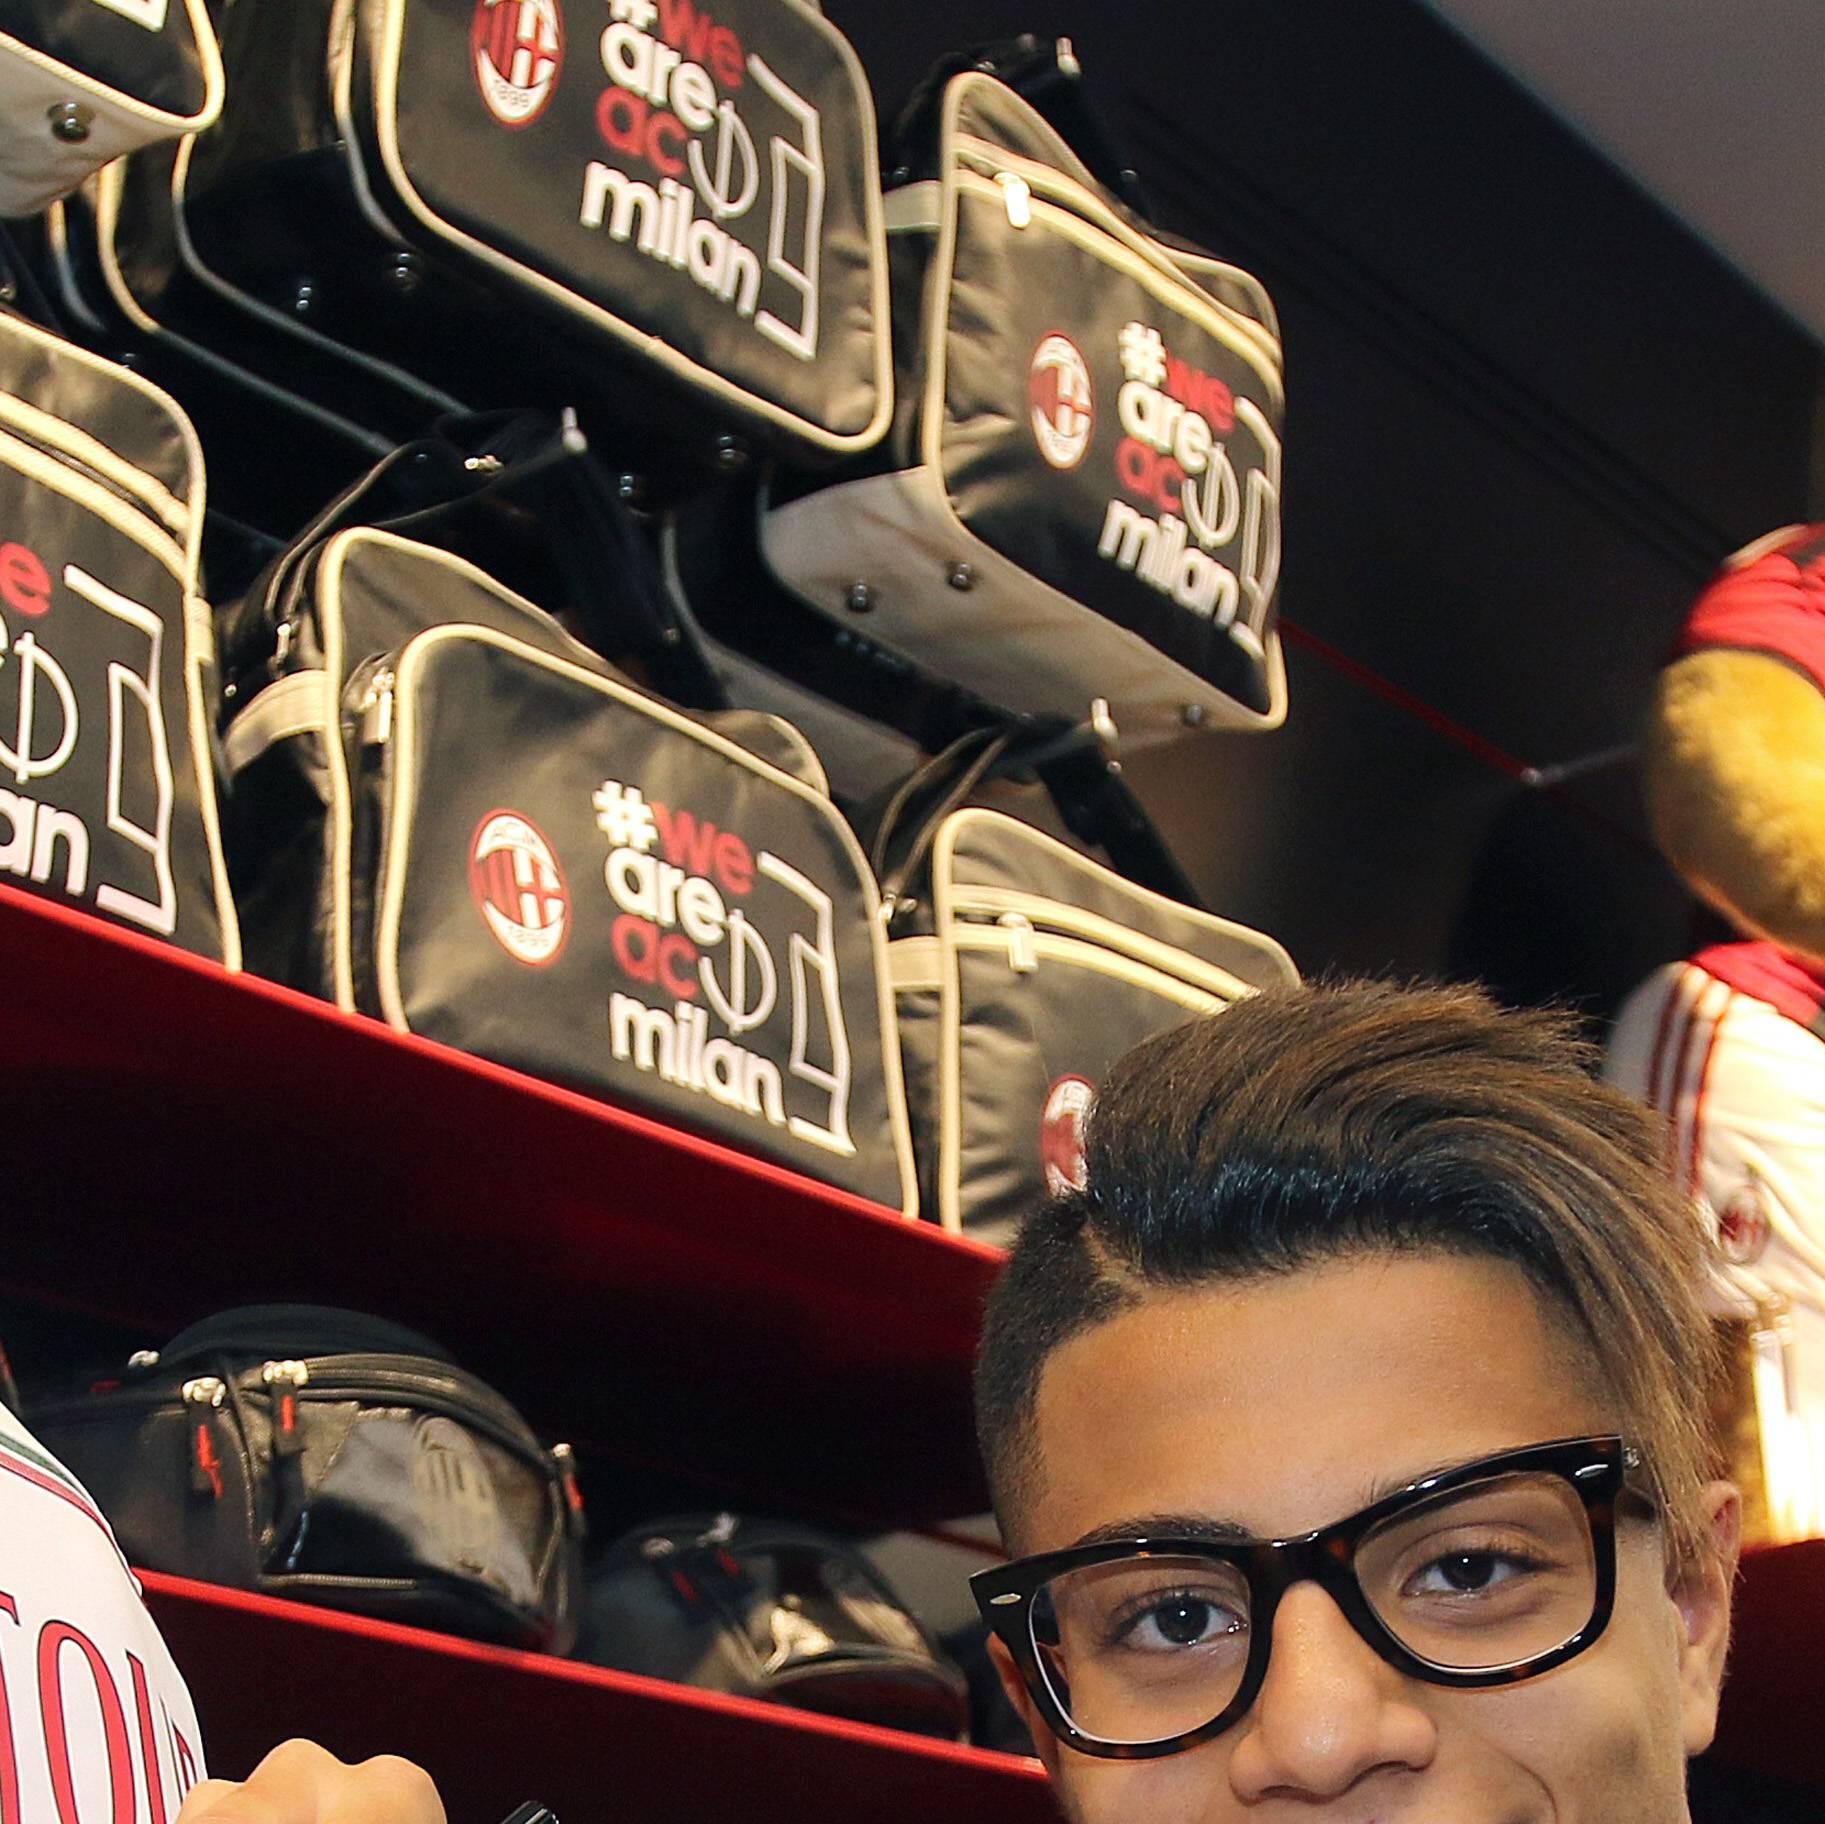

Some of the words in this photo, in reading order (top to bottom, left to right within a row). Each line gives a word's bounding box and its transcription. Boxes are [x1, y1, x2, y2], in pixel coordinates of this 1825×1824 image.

[595, 85, 688, 176] ac
[600, 21, 717, 132] are
[580, 160, 762, 317] milan
[1118, 320, 1236, 434] #we
[1118, 379, 1215, 475] are
[1114, 435, 1189, 514] ac
[1098, 498, 1240, 631] milan
[592, 778, 756, 895] #we
[604, 847, 729, 947] are
[611, 913, 700, 1000] ac
[609, 992, 788, 1126] milan
